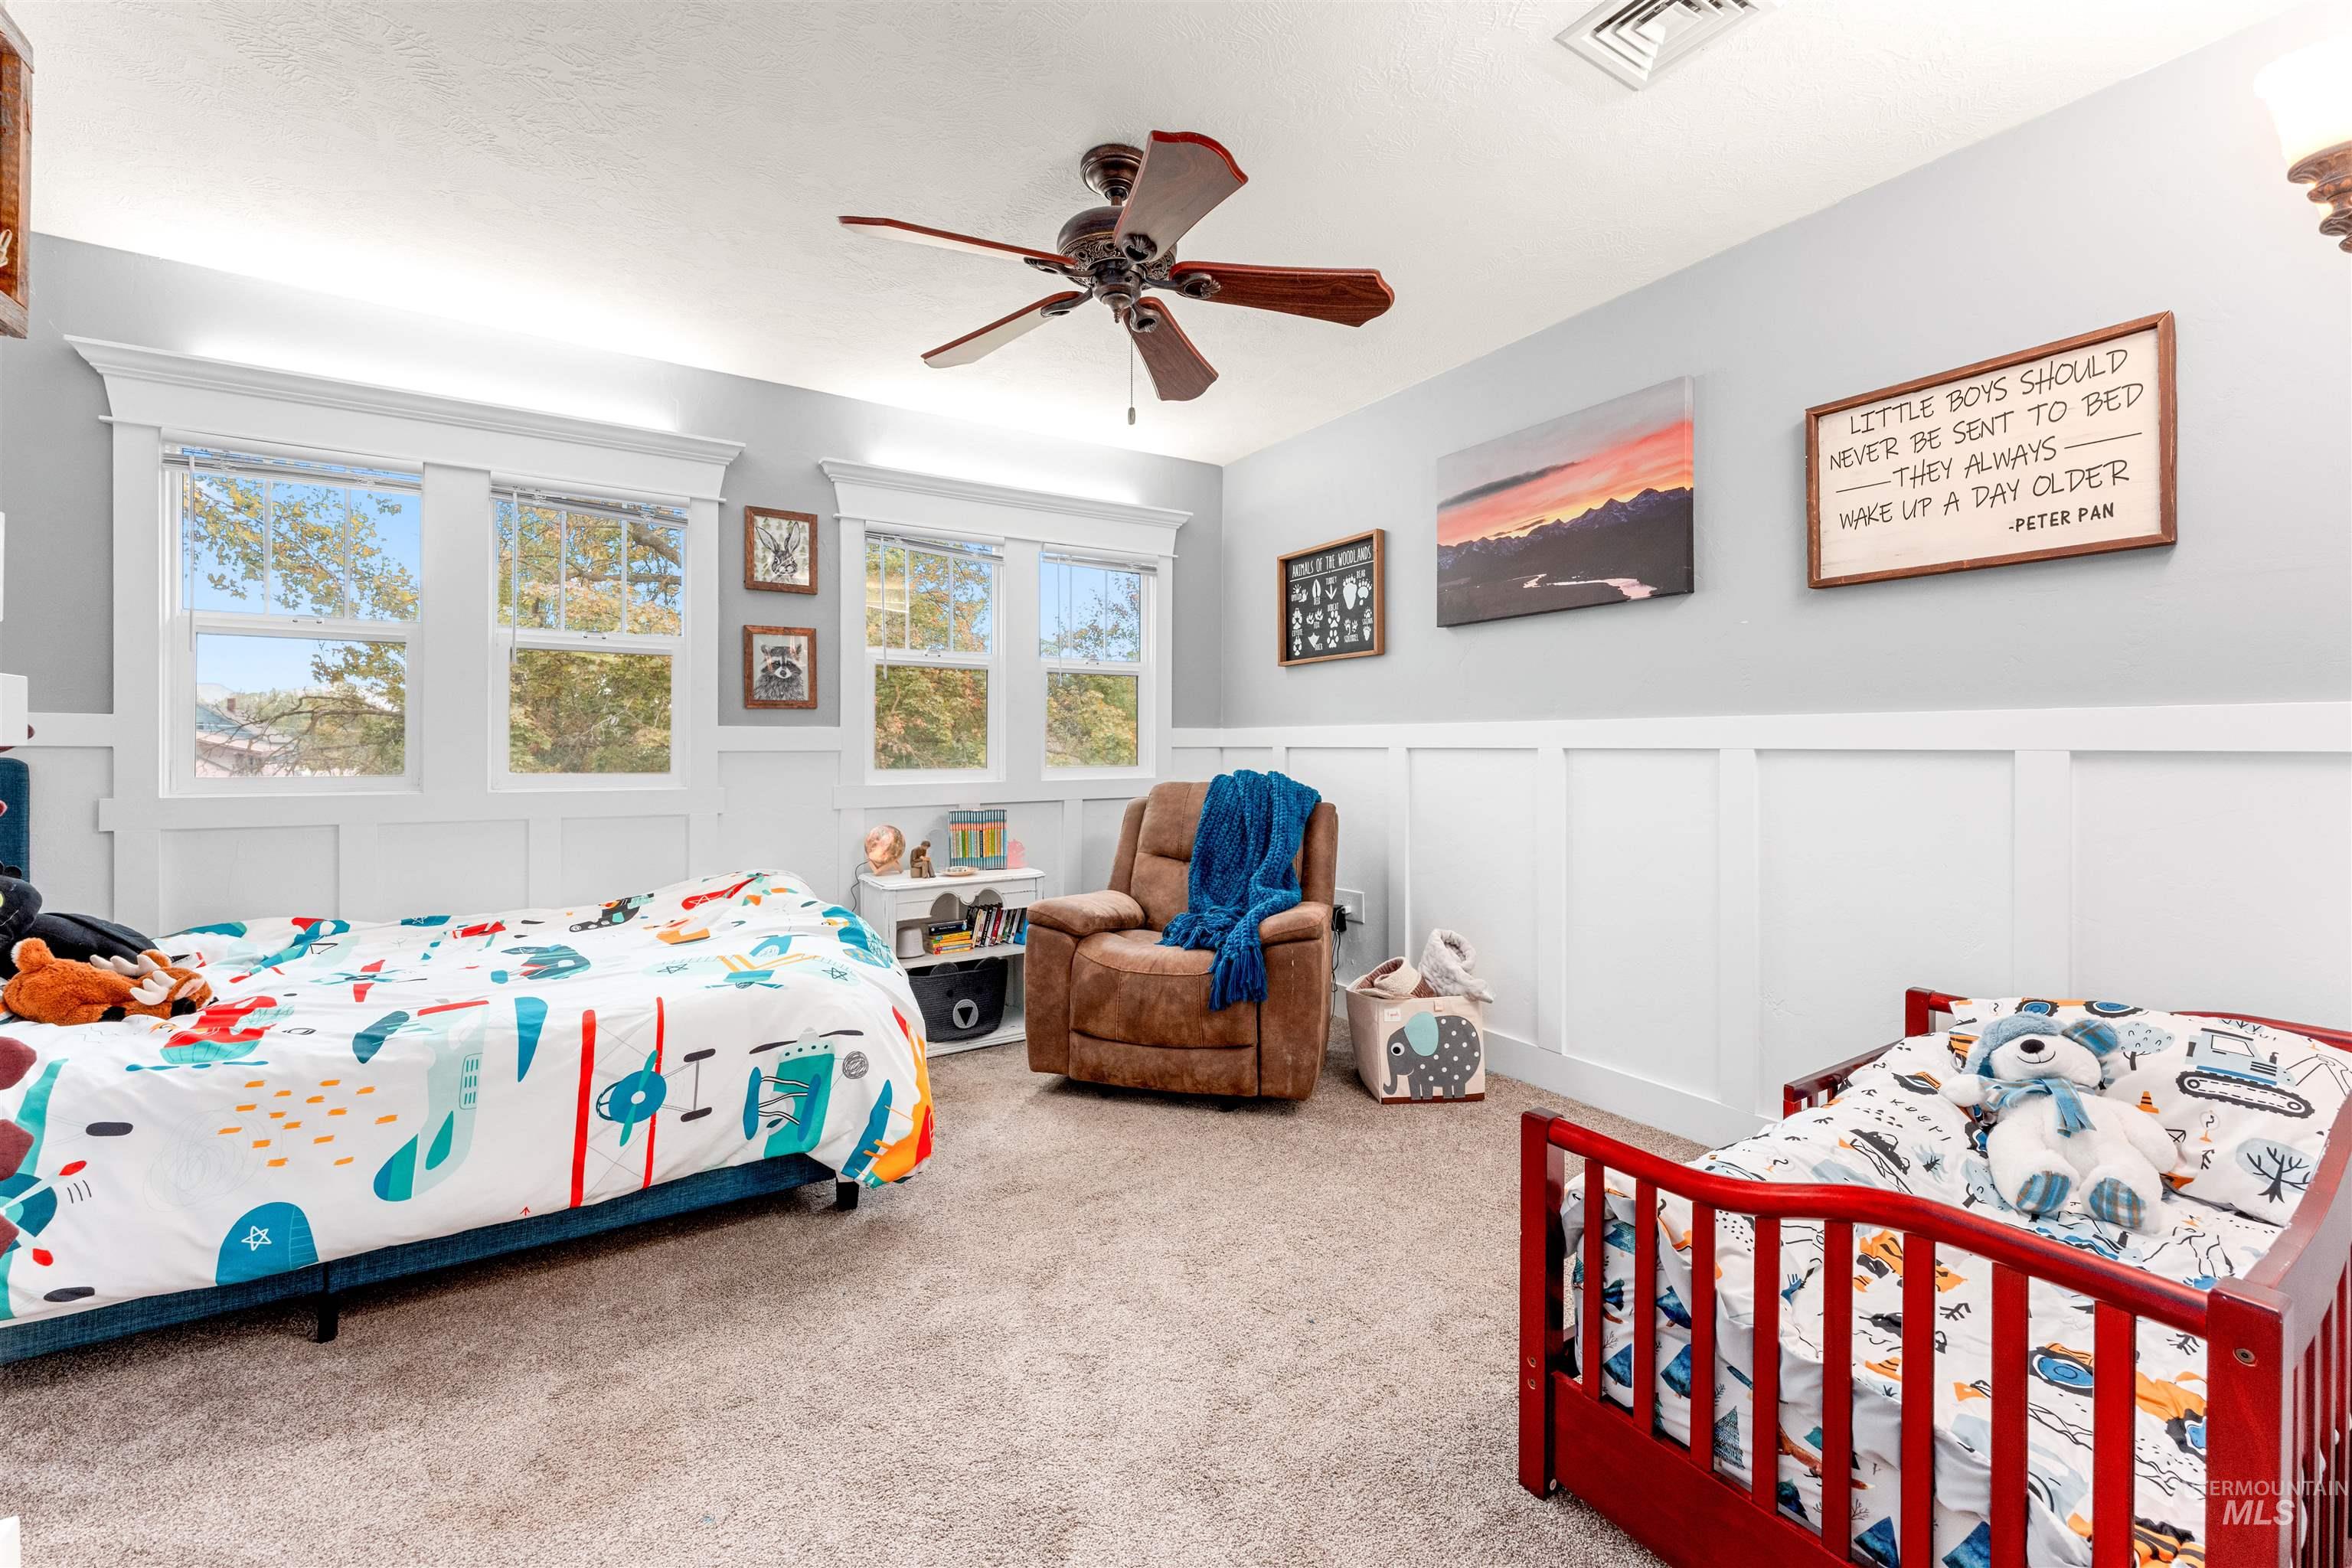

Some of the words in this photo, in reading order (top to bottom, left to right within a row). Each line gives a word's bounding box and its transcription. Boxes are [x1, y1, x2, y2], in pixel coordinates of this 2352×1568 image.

[1851, 396, 1934, 434] LITTLE
[1946, 377, 2007, 413] BOYS
[2022, 350, 2128, 395] SHOULD
[1830, 437, 1899, 470] NEVER
[1910, 427, 1942, 454] BE
[1953, 411, 2014, 444] SENT
[2027, 401, 2067, 426] TO
[2082, 383, 2144, 416] BED
[1893, 458, 1952, 488] THEY
[1965, 436, 2056, 479] ALWAYS
[1839, 502, 1893, 530] WAKE
[1903, 497, 1931, 520] UP
[1944, 492, 1959, 516] A
[1971, 479, 2020, 508] DAY
[2033, 459, 2129, 497] OLDER
[2009, 511, 2070, 531] -PETER
[2078, 502, 2114, 522] PAN
[1292, 560, 1314, 578] ANIMALS
[1316, 558, 1322, 572] OF
[1325, 554, 1335, 570] THE
[1338, 545, 1370, 567] WOODLANDS
